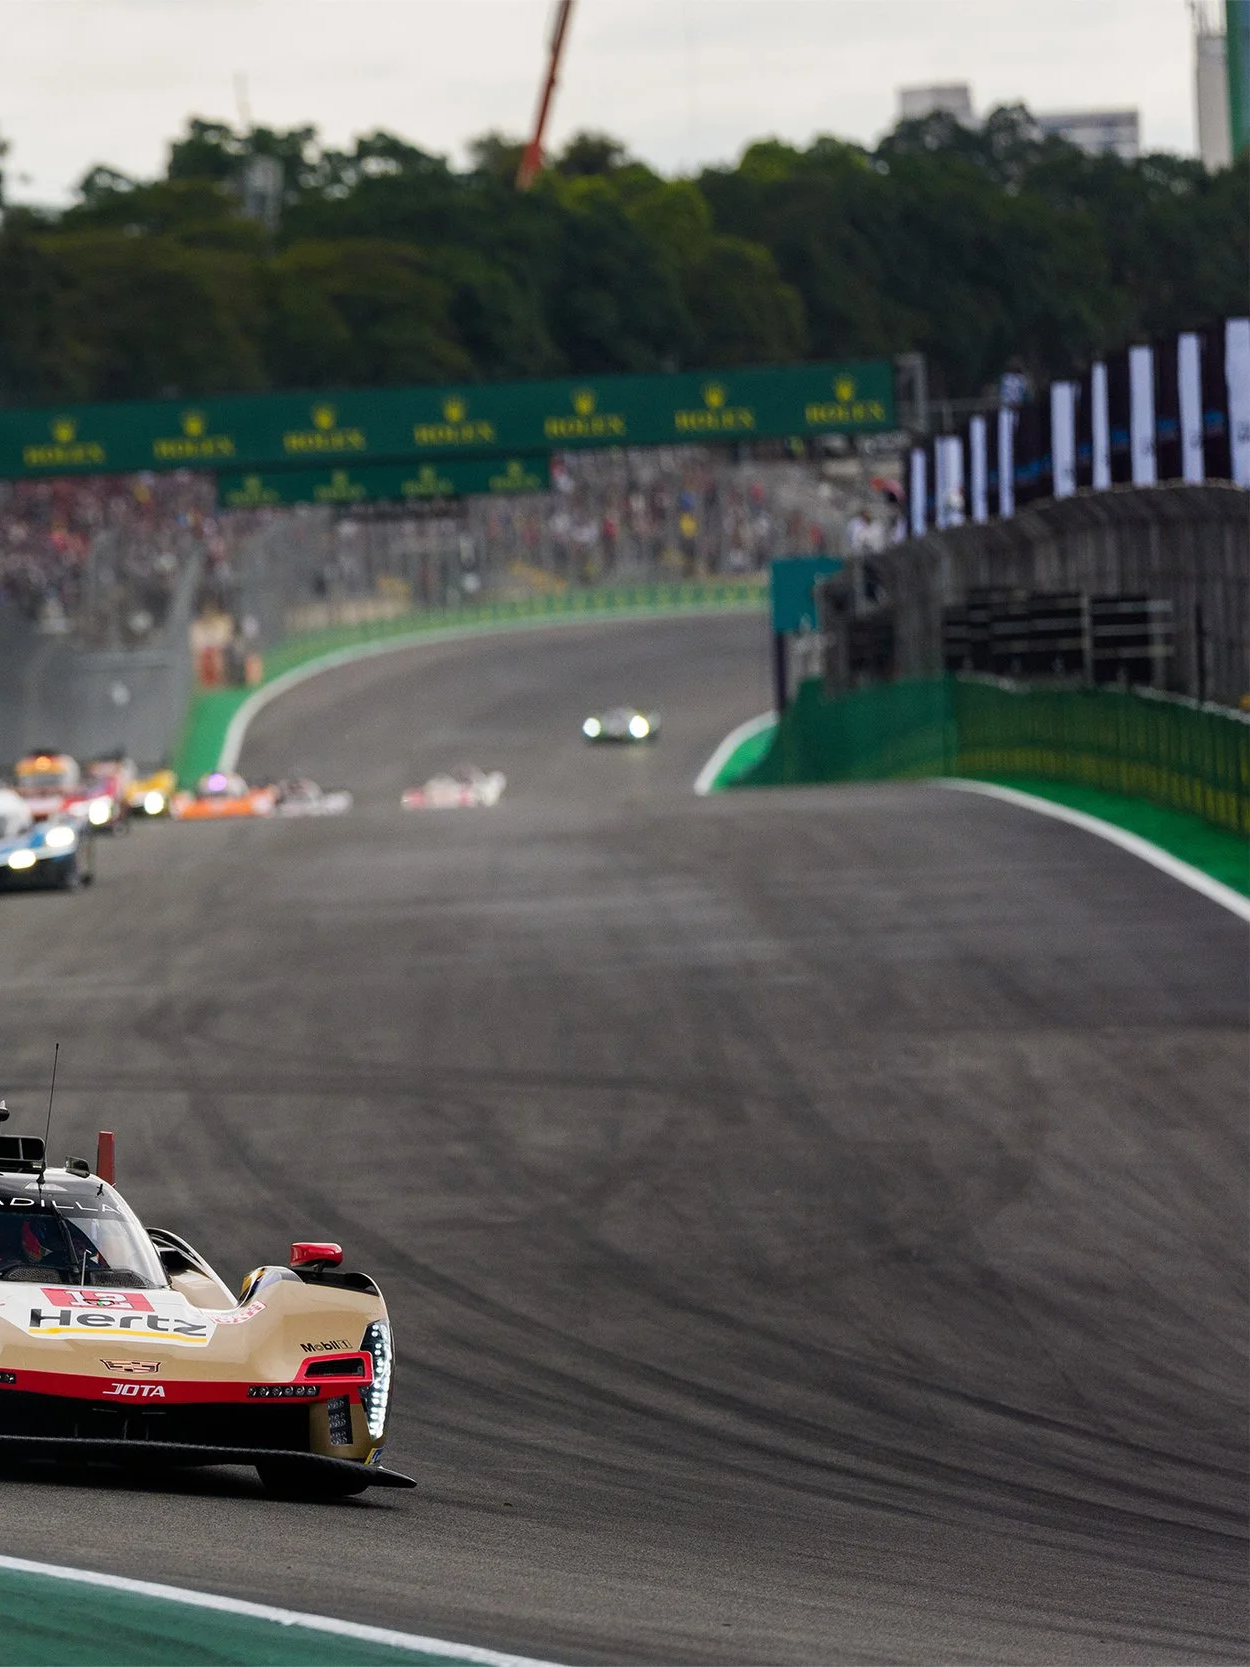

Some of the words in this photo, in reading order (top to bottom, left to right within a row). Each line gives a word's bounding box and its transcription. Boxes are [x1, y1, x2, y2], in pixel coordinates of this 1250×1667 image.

[29, 1308, 208, 1337] Hertz
[300, 1341, 340, 1352] Mobil
[102, 1382, 166, 1398] JOTA
